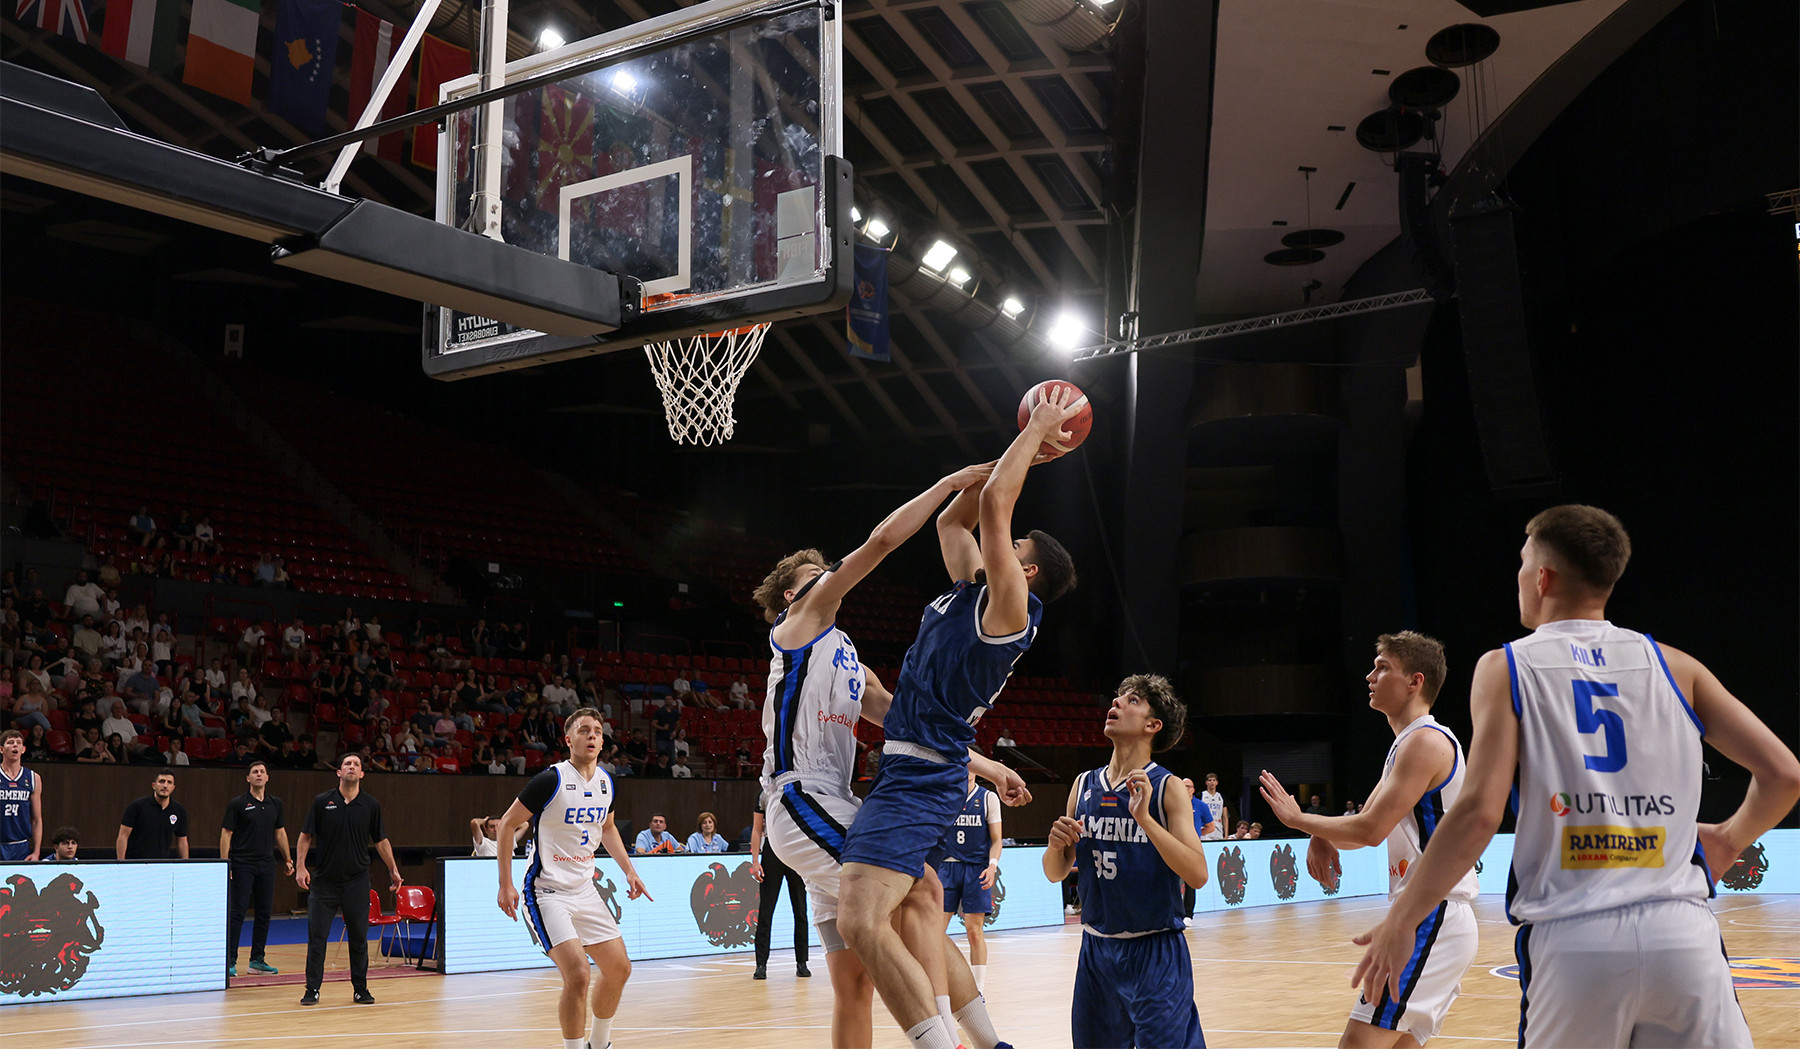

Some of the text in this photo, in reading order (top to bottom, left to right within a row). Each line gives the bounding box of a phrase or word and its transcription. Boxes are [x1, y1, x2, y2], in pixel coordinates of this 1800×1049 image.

[1570, 643, 1606, 667] KILK
[848, 678, 861, 701] 9
[1571, 679, 1628, 773] 5
[0, 790, 30, 801] RMENI
[4, 803, 19, 816] 24
[1575, 793, 1675, 816] UTILITAS
[564, 807, 607, 824] EESTI
[580, 829, 589, 845] 3
[956, 830, 965, 844] 8
[1570, 834, 1658, 851] RAMIRENT
[1092, 849, 1117, 880] 35
